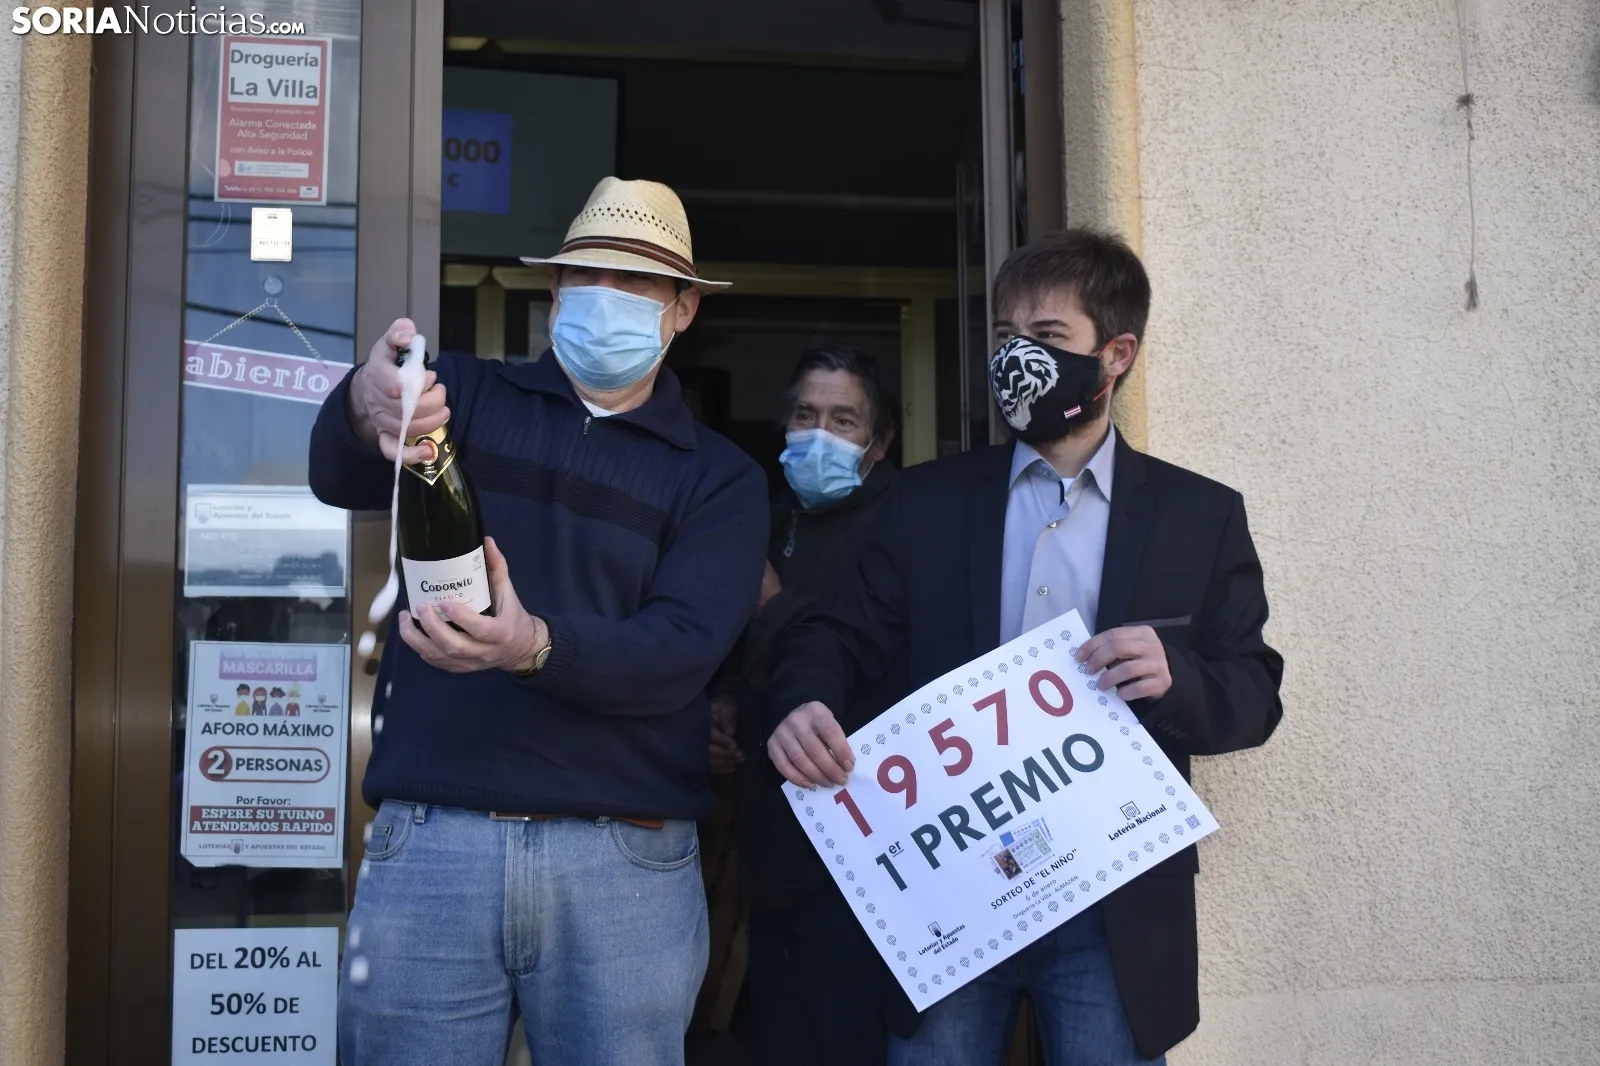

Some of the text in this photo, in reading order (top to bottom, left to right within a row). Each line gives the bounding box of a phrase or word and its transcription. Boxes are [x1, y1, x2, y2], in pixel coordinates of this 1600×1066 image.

[231, 49, 318, 69] Droguería
[230, 77, 318, 99] La Villa
[229, 118, 317, 130] Alarma Conectada
[237, 129, 308, 141] Alta Seguridad
[246, 146, 269, 155] Aviso
[277, 147, 286, 155] la
[185, 352, 330, 393] abierto
[222, 661, 315, 675] MASCARILLA
[201, 720, 334, 737] AFORO MÁXIMO
[207, 749, 323, 775] 2 PERSONAS
[833, 670, 1073, 837] 19570
[236, 796, 291, 806] Por Favor:
[910, 733, 1104, 870] PREMIO
[201, 808, 325, 820] ESPERE SU TURNO
[1135, 803, 1167, 826] Nacional
[192, 820, 333, 833] ATENDEMOS RAPIDO
[990, 885, 1023, 910] SORTEO
[1023, 877, 1037, 890] DE
[1031, 890, 1040, 898] de
[1040, 879, 1057, 892] enero
[942, 923, 966, 941] Apuestas
[933, 936, 959, 955] del Estado
[190, 946, 322, 970] DEL 20% AL
[210, 992, 300, 1015] 50% DE
[192, 1034, 317, 1054] DESCUENTO
